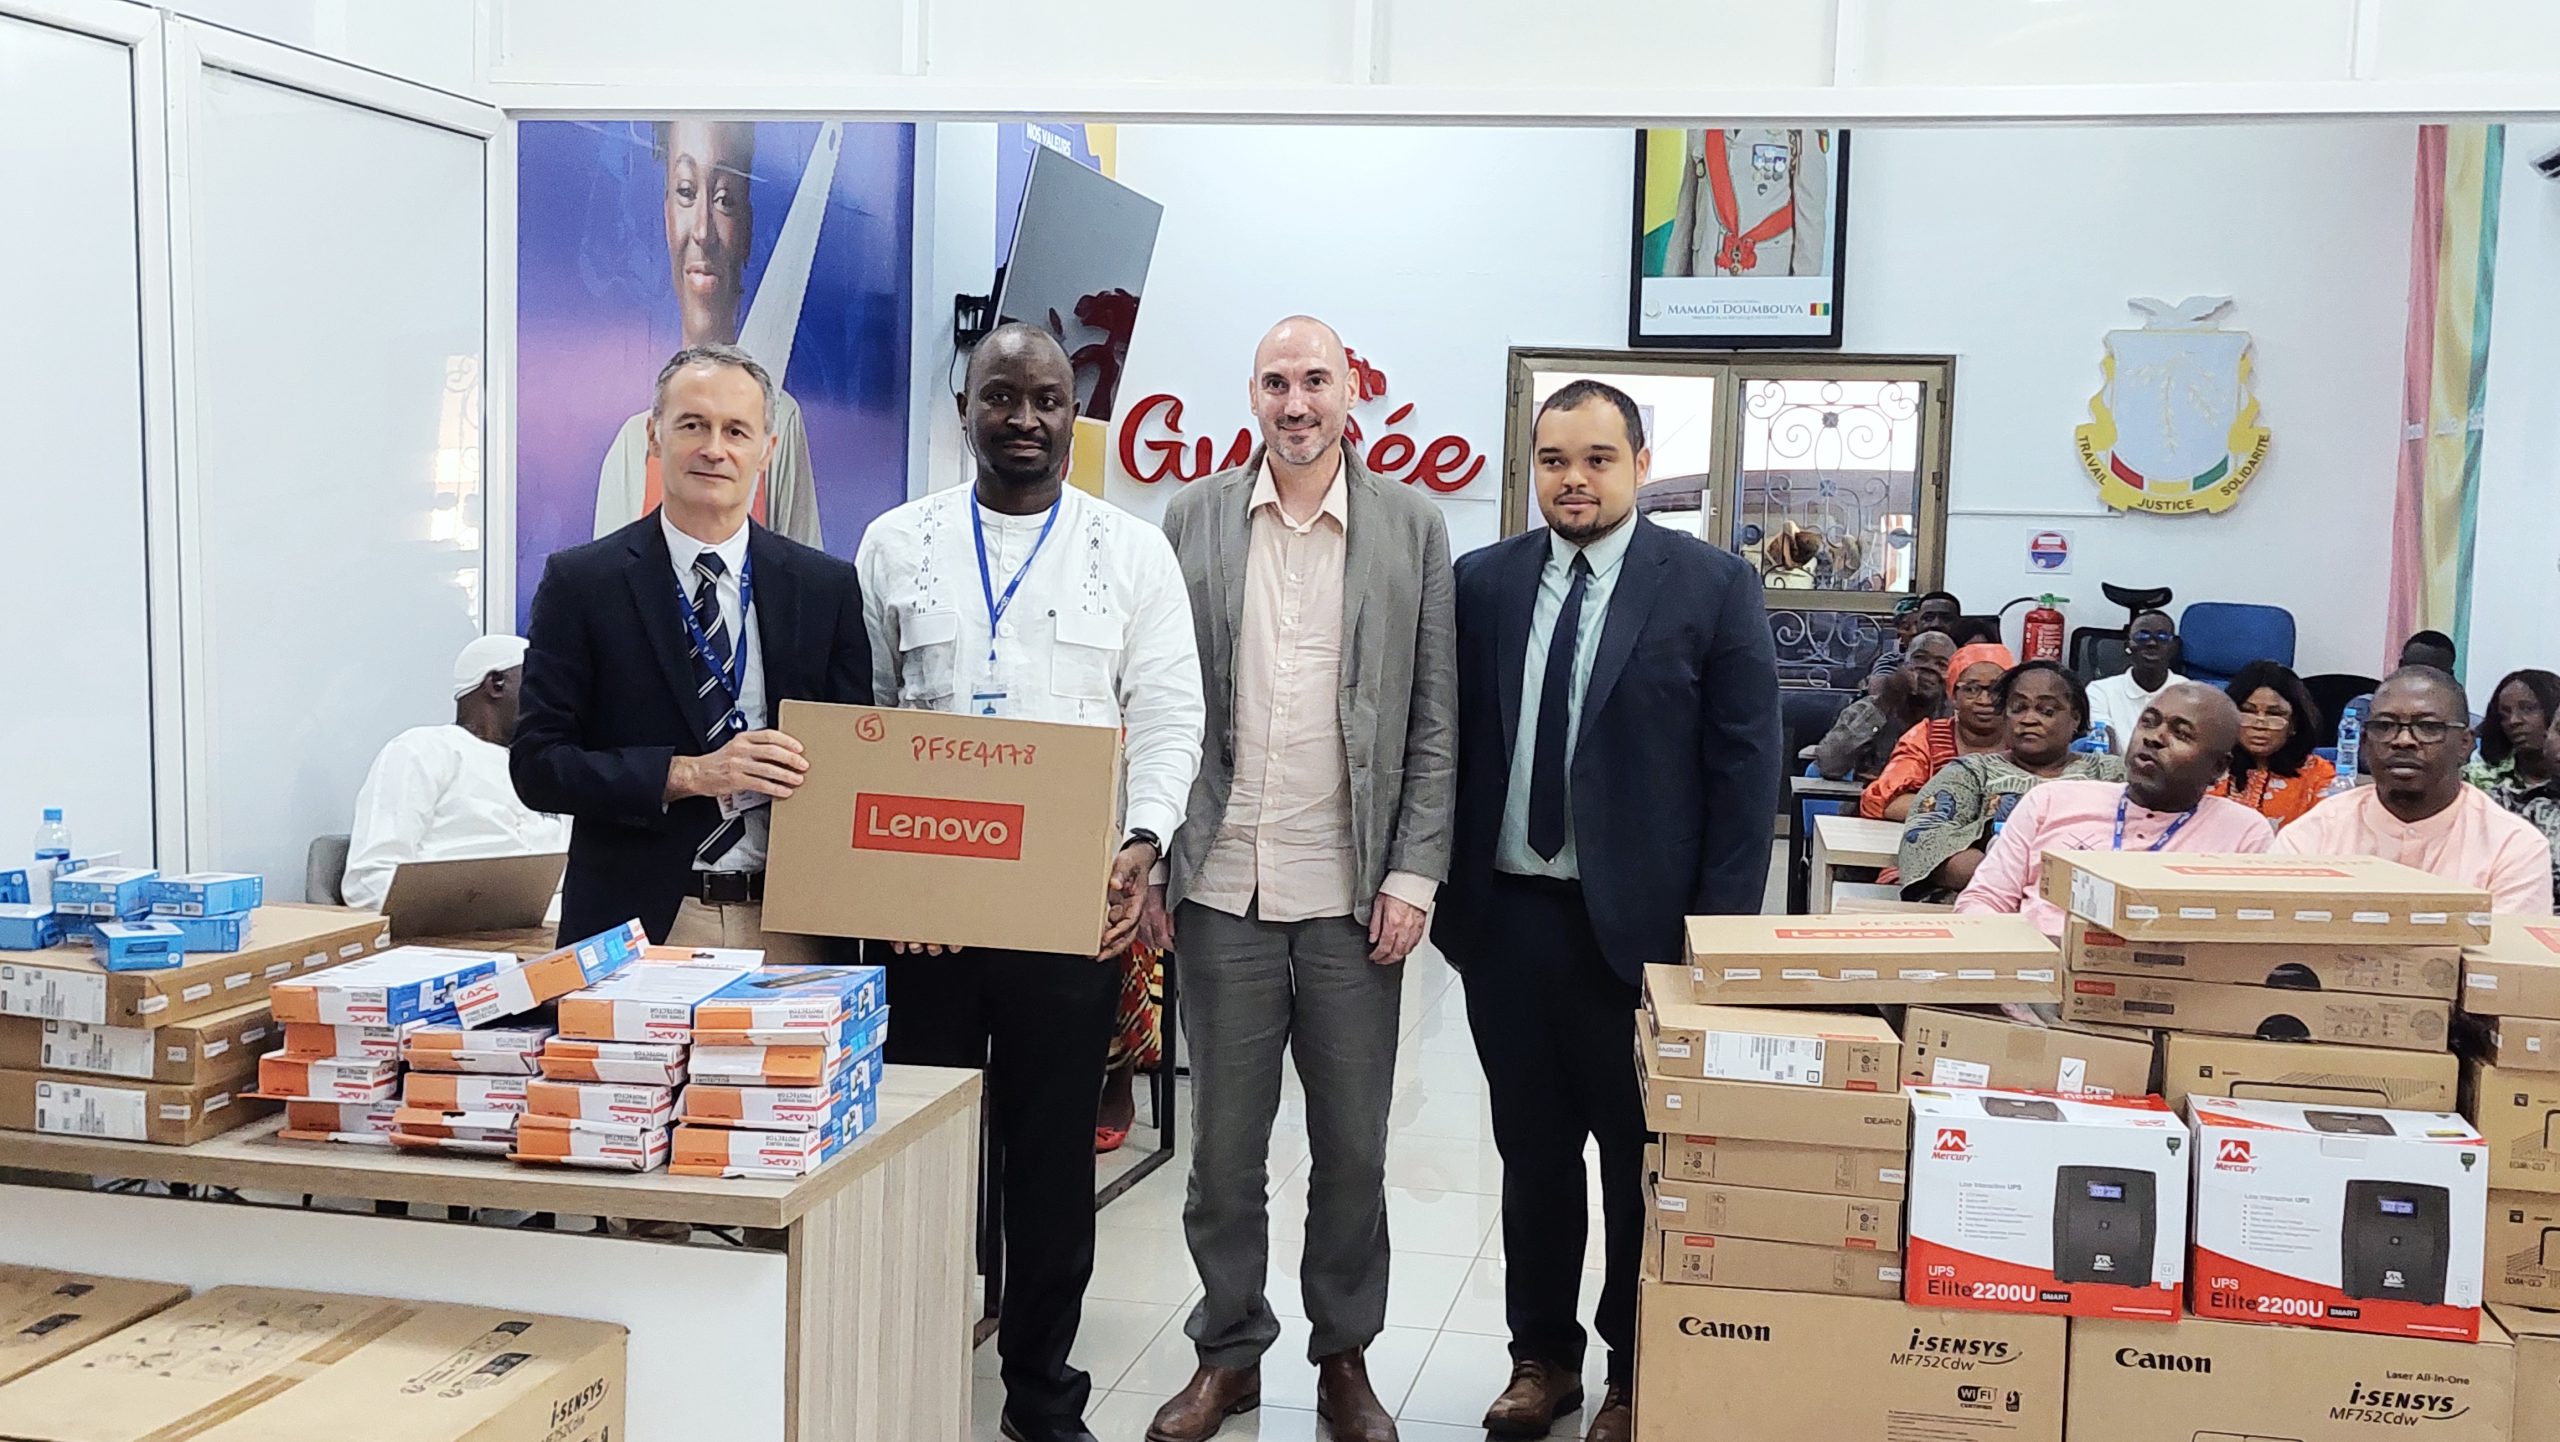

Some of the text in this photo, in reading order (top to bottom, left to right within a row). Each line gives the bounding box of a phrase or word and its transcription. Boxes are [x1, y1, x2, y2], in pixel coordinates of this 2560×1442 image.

[1026, 121, 1041, 143] NOS
[1667, 303, 1803, 315] MAMADI DOUMBOUYA
[2077, 435, 2108, 486] TRAVAIL
[2136, 497, 2196, 511] JUSTICE
[868, 805, 1008, 846] Lenovo
[1931, 1151, 1974, 1164] Mercury
[2212, 1162, 2258, 1175] Mercury
[2007, 1183, 2022, 1191] UPS
[1927, 1264, 1956, 1278] UPS
[2210, 1277, 2240, 1290] UPS
[2041, 1292, 2069, 1302] SMART
[2329, 1307, 2358, 1318] SMART
[1678, 1316, 1771, 1342] Canon
[1909, 1328, 2009, 1358] i-SENSYS
[1889, 1352, 1975, 1371] MF752Cdw
[2115, 1347, 2212, 1374] Canon
[2386, 1370, 2414, 1381] Laser
[2349, 1381, 2455, 1413] i-SENSYS
[2329, 1406, 2419, 1427] MF752Cdw
